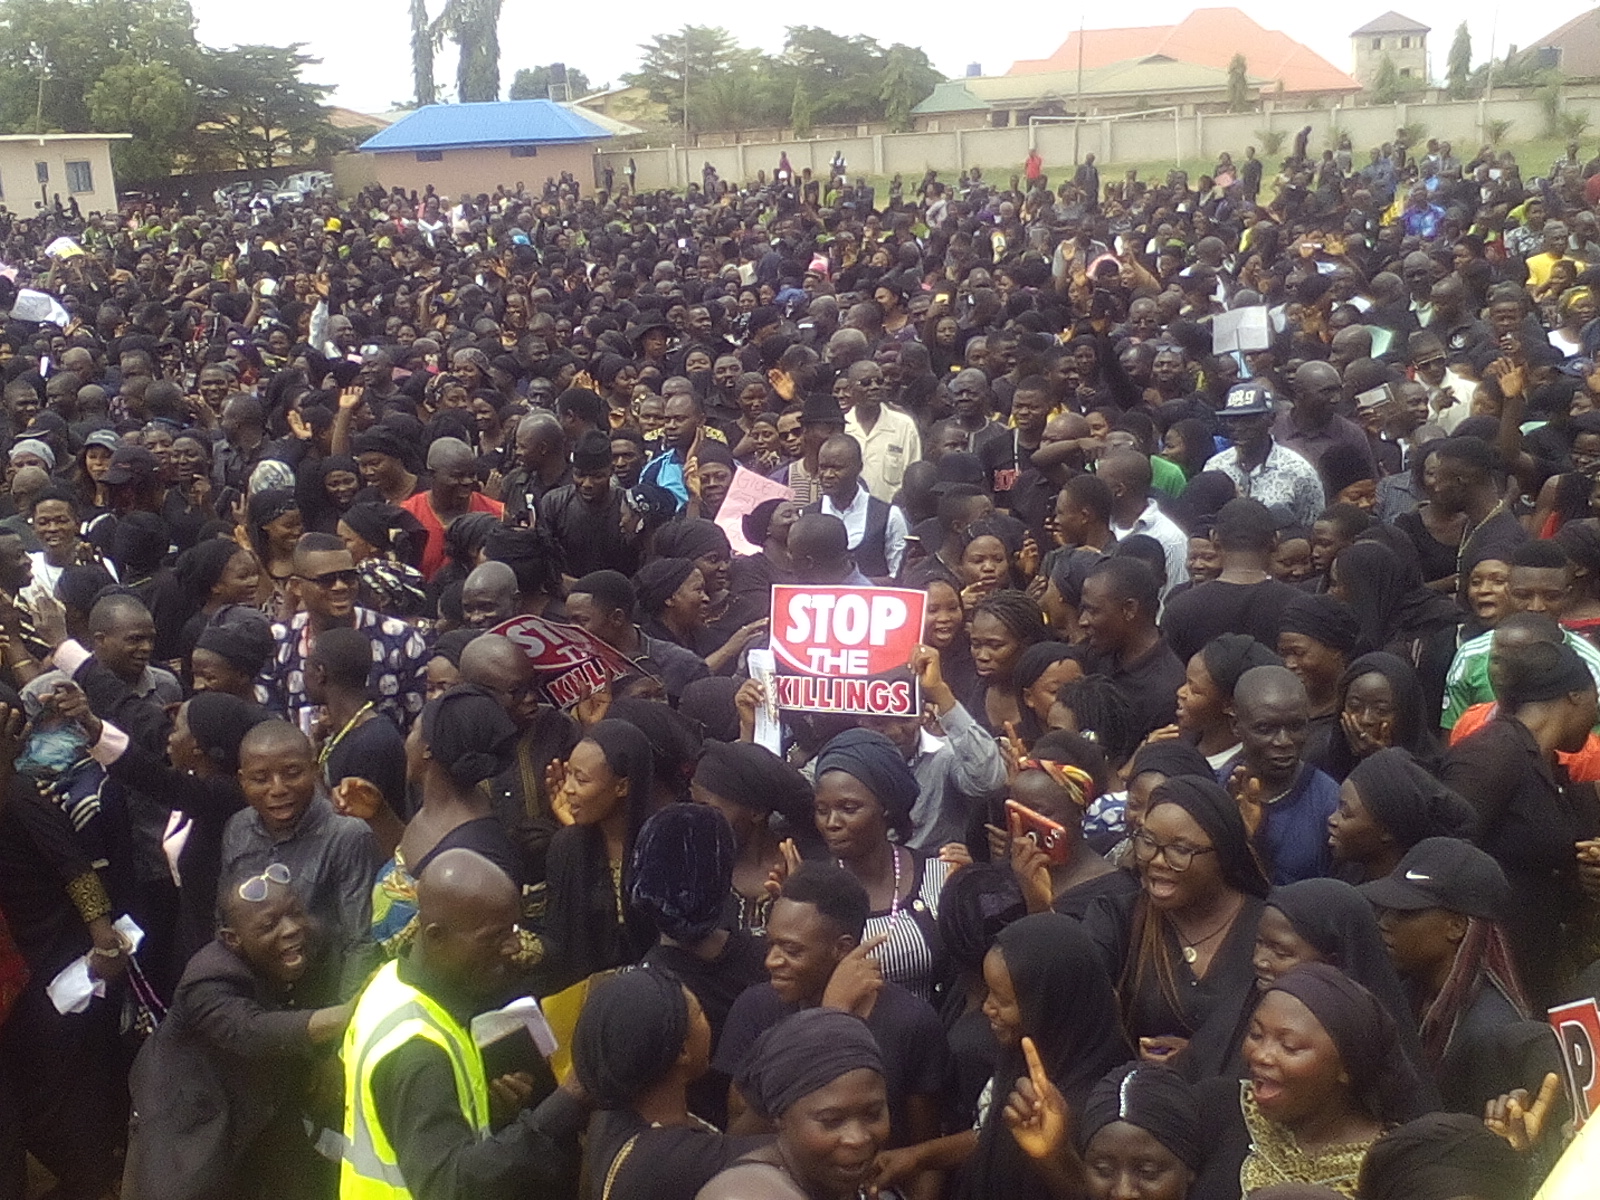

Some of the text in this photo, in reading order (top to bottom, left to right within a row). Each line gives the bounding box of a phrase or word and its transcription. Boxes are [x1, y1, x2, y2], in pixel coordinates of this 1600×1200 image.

[786, 592, 908, 646] STOP
[806, 647, 869, 675] THE
[775, 675, 910, 713] KILLINGS
